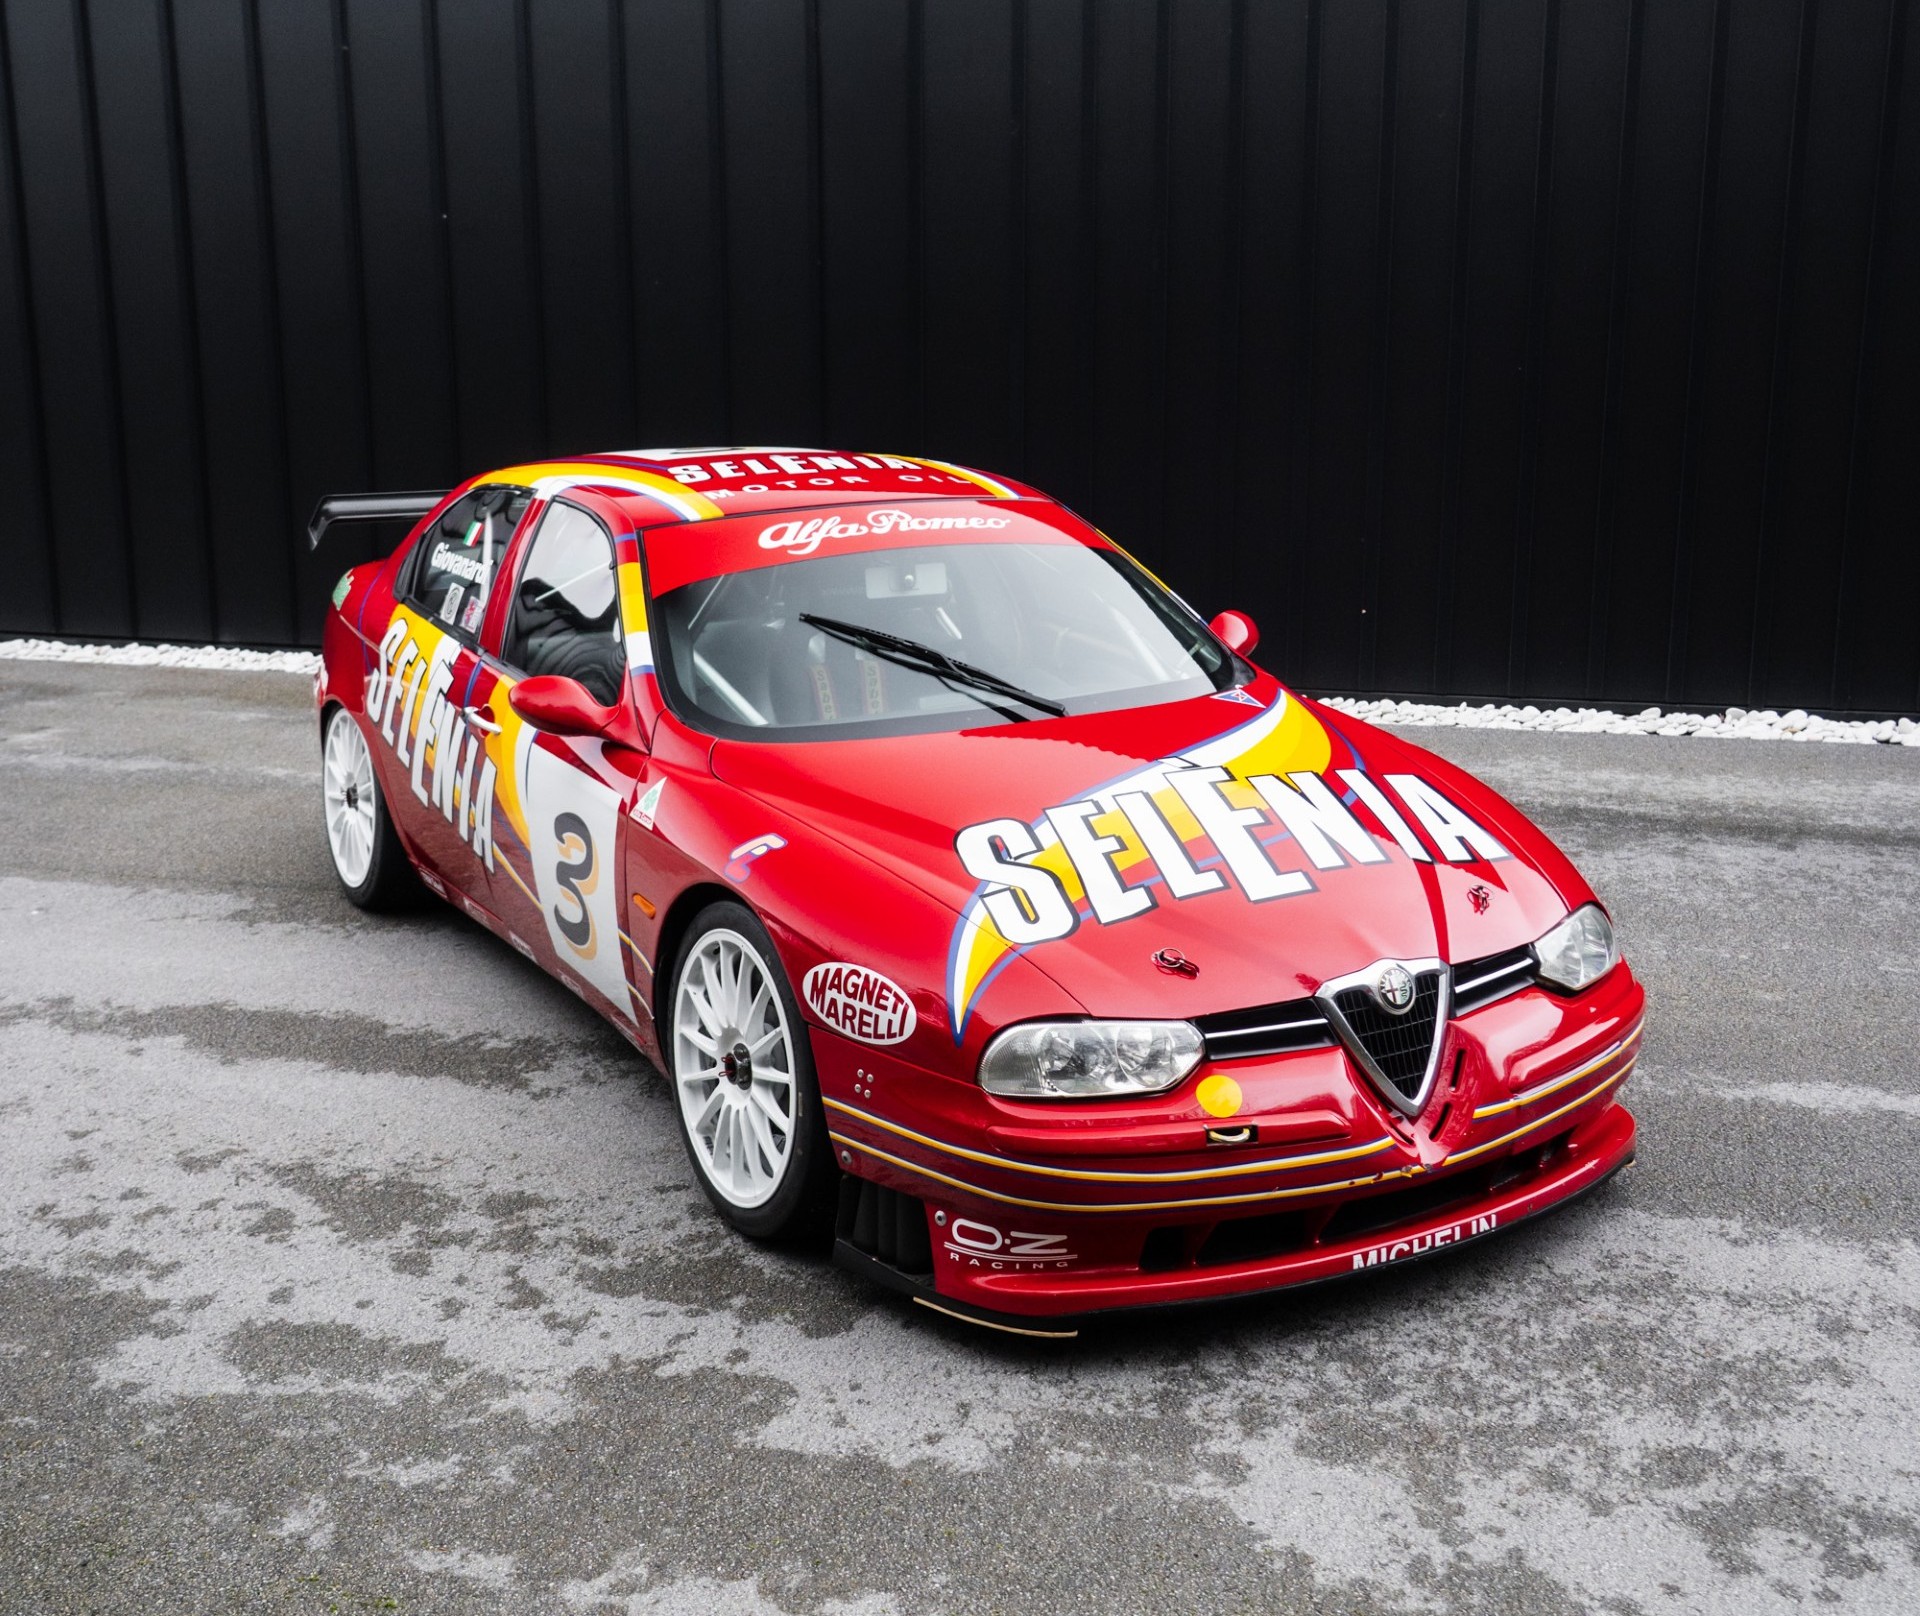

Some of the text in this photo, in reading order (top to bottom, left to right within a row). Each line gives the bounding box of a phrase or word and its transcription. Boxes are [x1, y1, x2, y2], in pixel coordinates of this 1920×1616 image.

[703, 474, 972, 500] MOTOR OIL
[757, 509, 1011, 555] Alfa Romeo
[816, 669, 833, 720] Sabe
[867, 665, 881, 714] Sabe
[554, 811, 598, 960] 3
[810, 967, 909, 1037] MAGNETI
[950, 1252, 1068, 1270] RACING
[1353, 1213, 1497, 1270] MICHELIN
